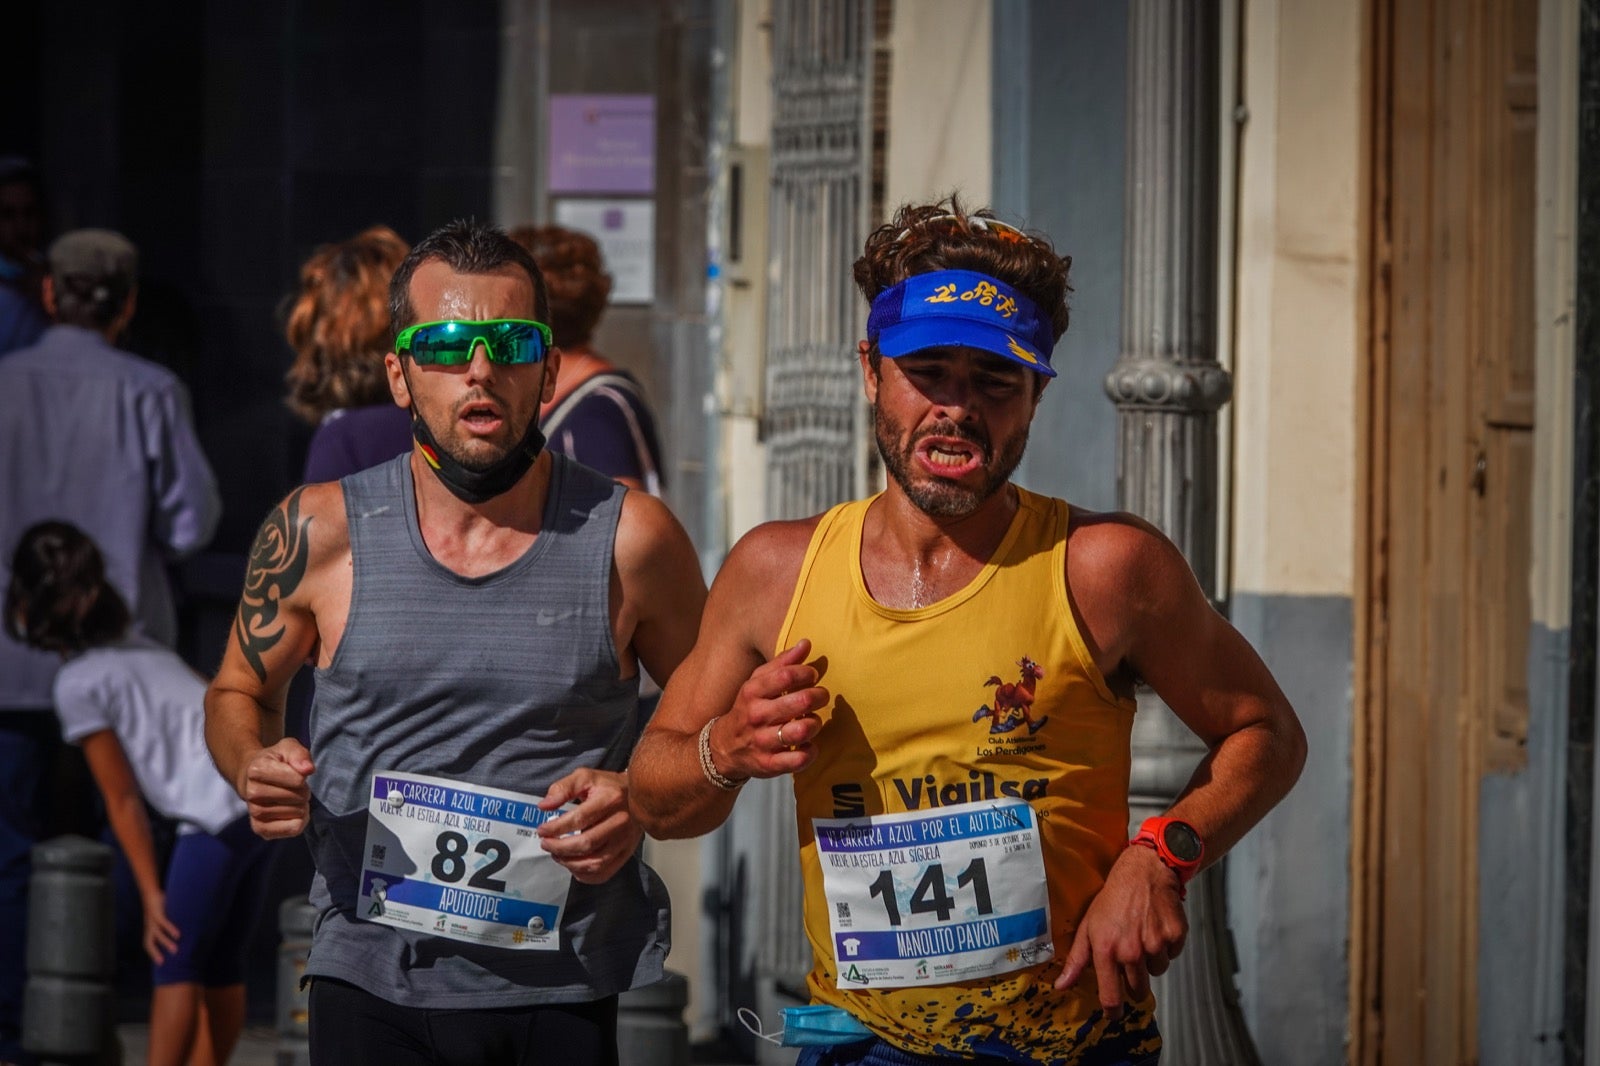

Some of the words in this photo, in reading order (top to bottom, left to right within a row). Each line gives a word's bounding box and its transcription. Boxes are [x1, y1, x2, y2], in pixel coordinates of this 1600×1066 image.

[977, 746, 992, 757] Los
[995, 744, 1047, 756] Perdigones
[988, 736, 1004, 745] Club
[403, 783, 446, 806] CARRERA
[451, 791, 475, 812] AZUL
[480, 797, 502, 817] POR
[505, 802, 516, 819] EL
[406, 805, 415, 819] LA
[417, 807, 440, 825] ESTELA
[443, 813, 460, 828] AZUL
[826, 829, 838, 848] VI
[840, 827, 883, 848] CARRERA
[889, 824, 917, 844] AZUL
[921, 819, 945, 841] POR
[949, 817, 963, 836] EL
[969, 808, 1018, 833] AUTISMO
[431, 831, 511, 892] 82
[828, 853, 850, 868] VUELVE
[850, 853, 860, 868] LA
[860, 851, 885, 868] ESTELA
[889, 849, 907, 866] AZUL
[438, 888, 502, 921] APUTOTOPE
[869, 857, 993, 926] 141
[896, 927, 954, 957] MANOLITO
